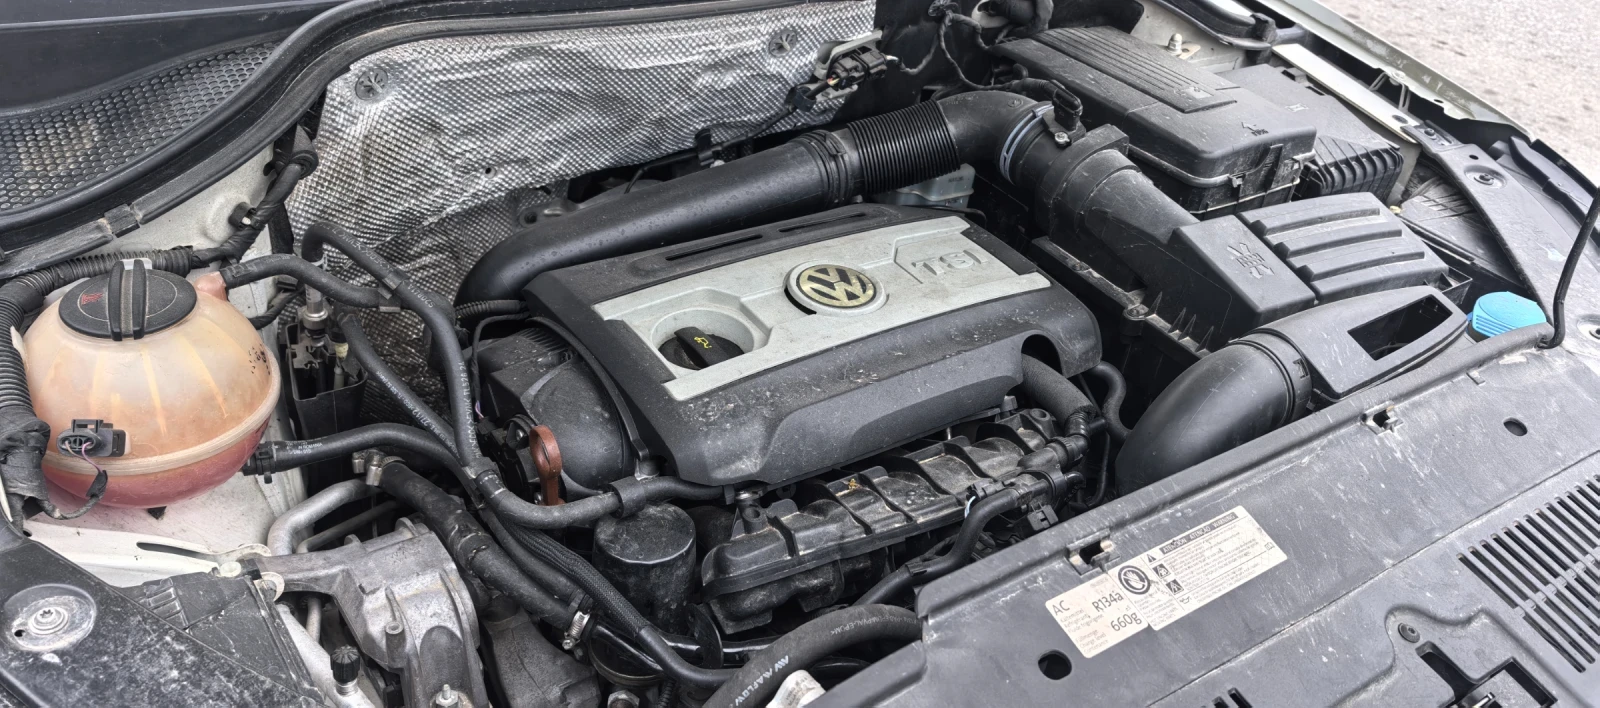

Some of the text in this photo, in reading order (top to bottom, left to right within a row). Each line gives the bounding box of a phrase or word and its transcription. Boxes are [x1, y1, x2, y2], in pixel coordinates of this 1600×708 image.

[911, 249, 988, 275] TSI
[796, 264, 876, 308] VW
[1052, 600, 1070, 615] AC
[1092, 592, 1123, 612] R134a
[1110, 612, 1142, 631] 660g
[735, 668, 772, 706] MAFLOW
